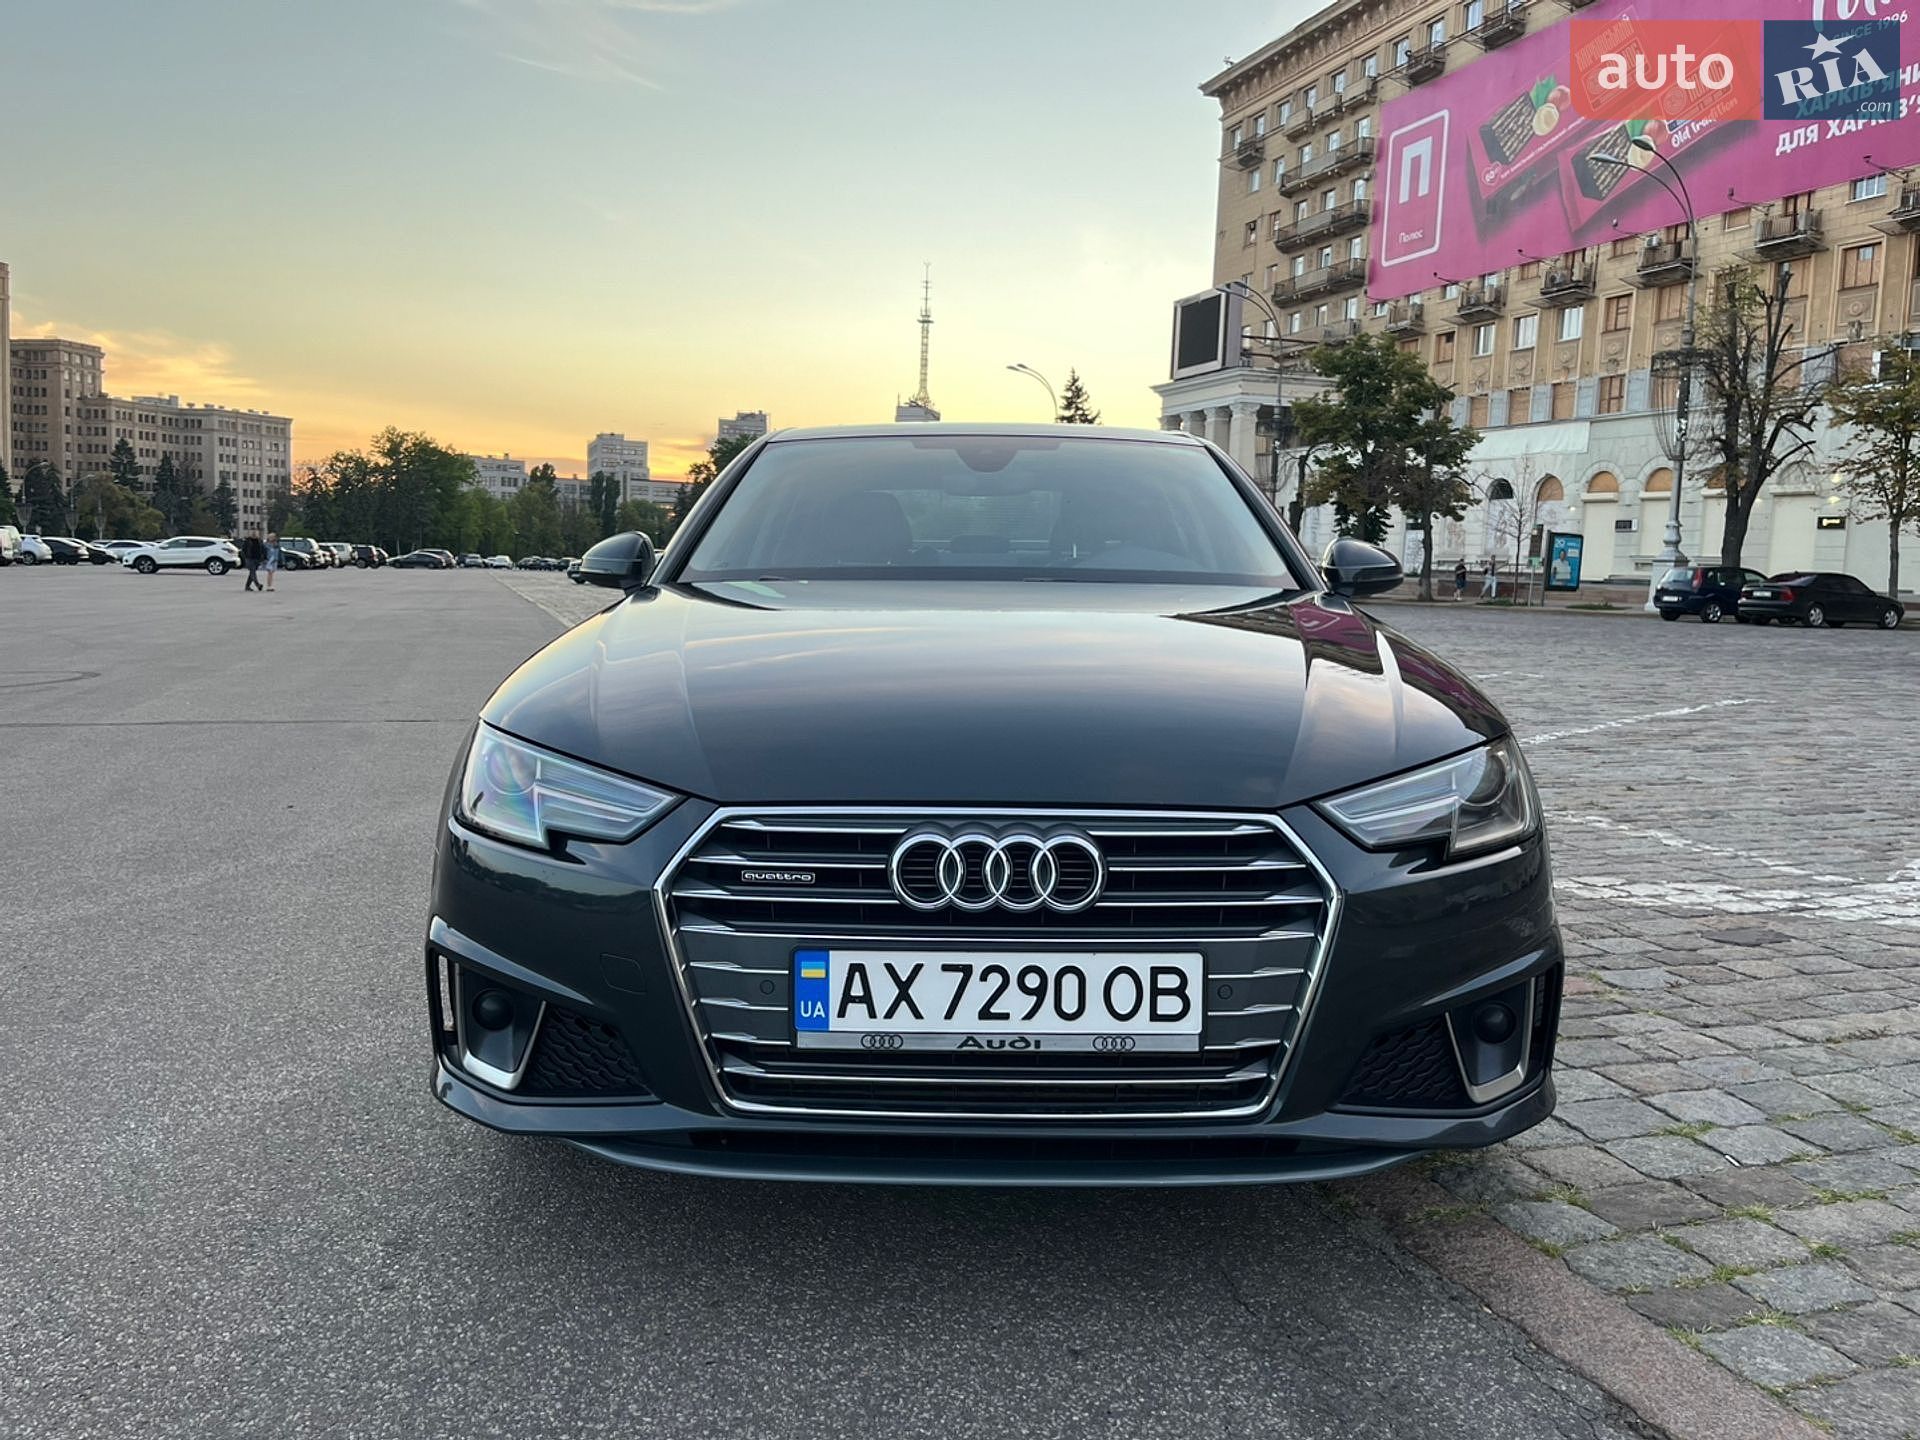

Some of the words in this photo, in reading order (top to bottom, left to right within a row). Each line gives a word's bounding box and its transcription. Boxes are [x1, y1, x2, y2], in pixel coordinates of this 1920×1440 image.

[1775, 123, 1819, 156] ДЛЯ
[744, 872, 812, 882] quattro
[836, 962, 925, 1020] AX
[941, 963, 1087, 1022] 7290
[1102, 965, 1191, 1022] OB
[800, 1000, 826, 1018] UA
[956, 1035, 1041, 1050] Audi
